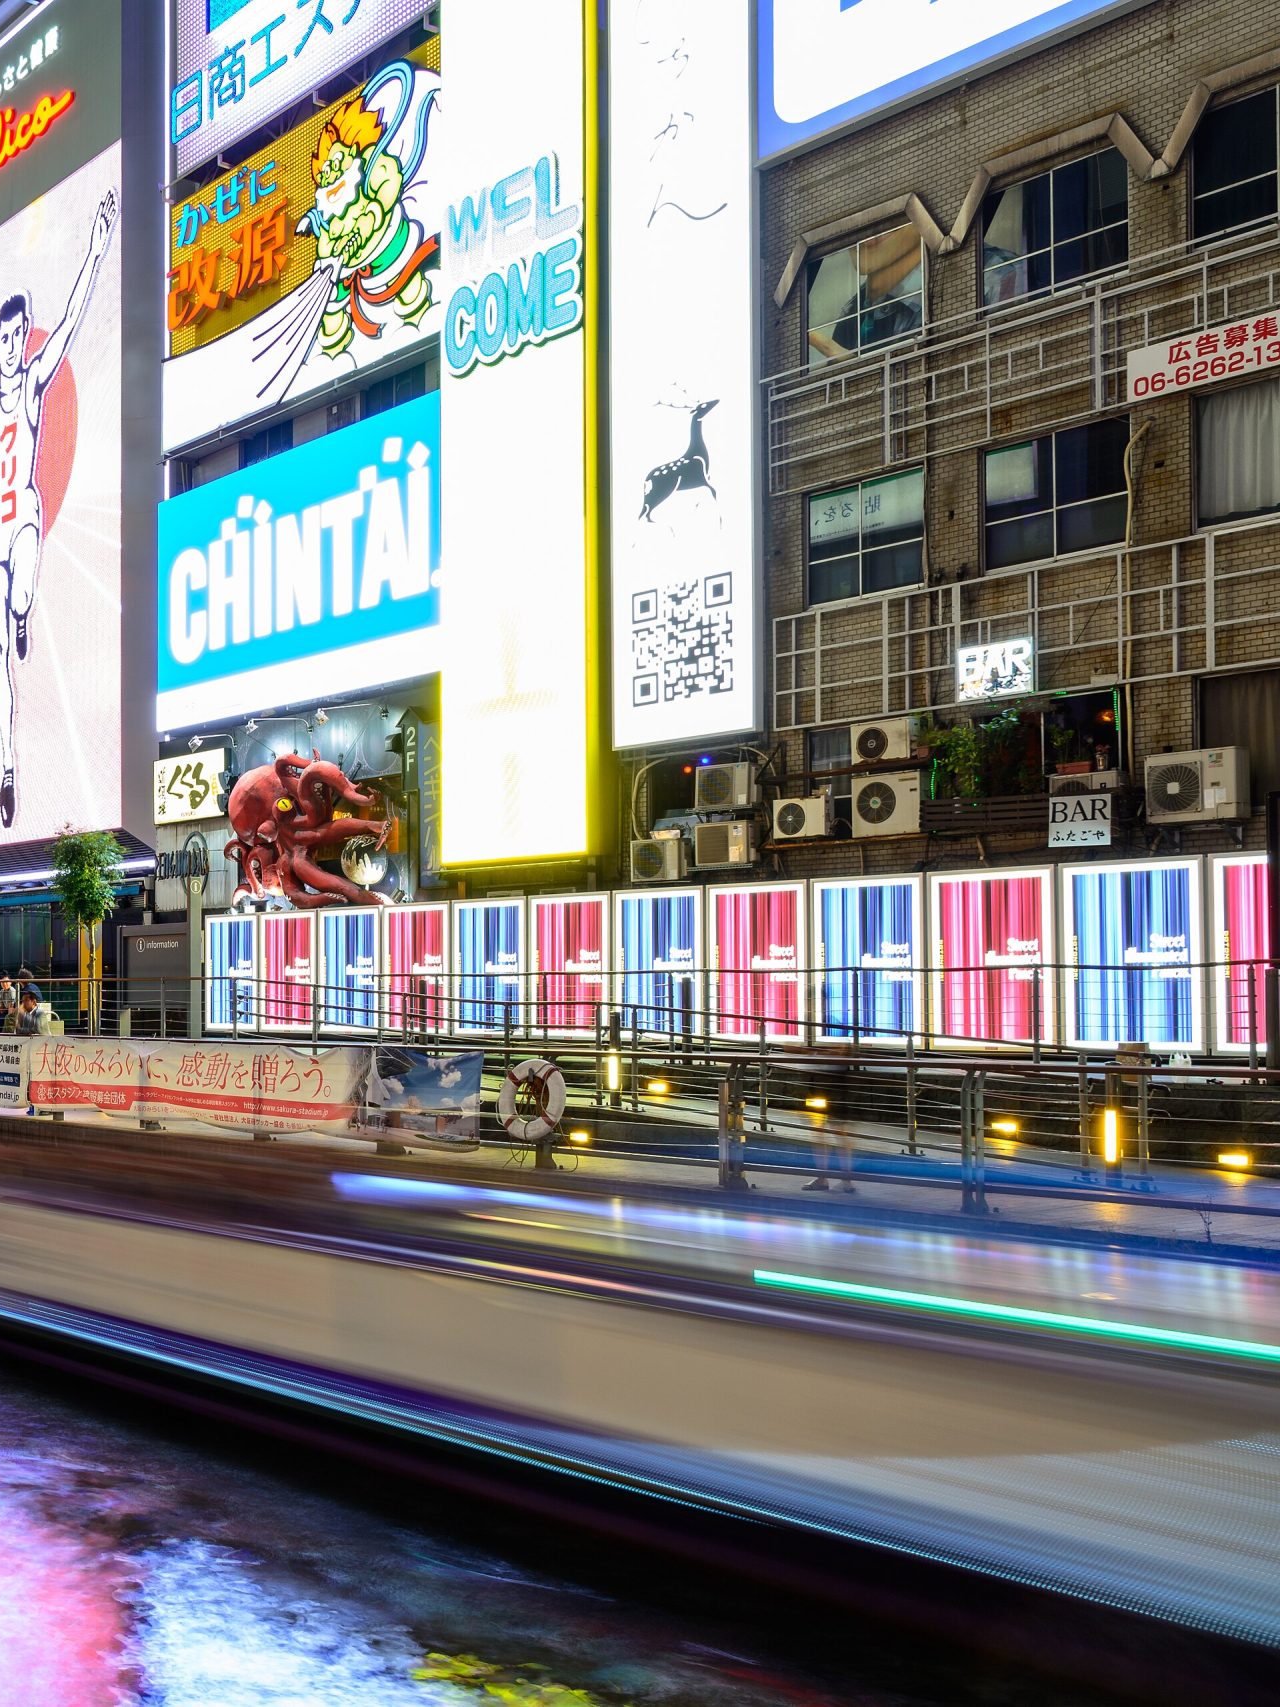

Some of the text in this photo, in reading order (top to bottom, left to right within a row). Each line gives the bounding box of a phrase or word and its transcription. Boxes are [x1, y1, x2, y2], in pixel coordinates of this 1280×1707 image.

[176, 161, 278, 248] かぜに
[445, 152, 579, 262] WEL
[167, 199, 288, 331] 改源
[445, 237, 578, 371] COME
[1167, 316, 1280, 365] 広告募集
[0, 413, 18, 524] グリコ
[960, 643, 1033, 681] BAR
[1050, 798, 1110, 824] BAR
[1052, 830, 1106, 843] ふたごや
[145, 940, 179, 950] information
